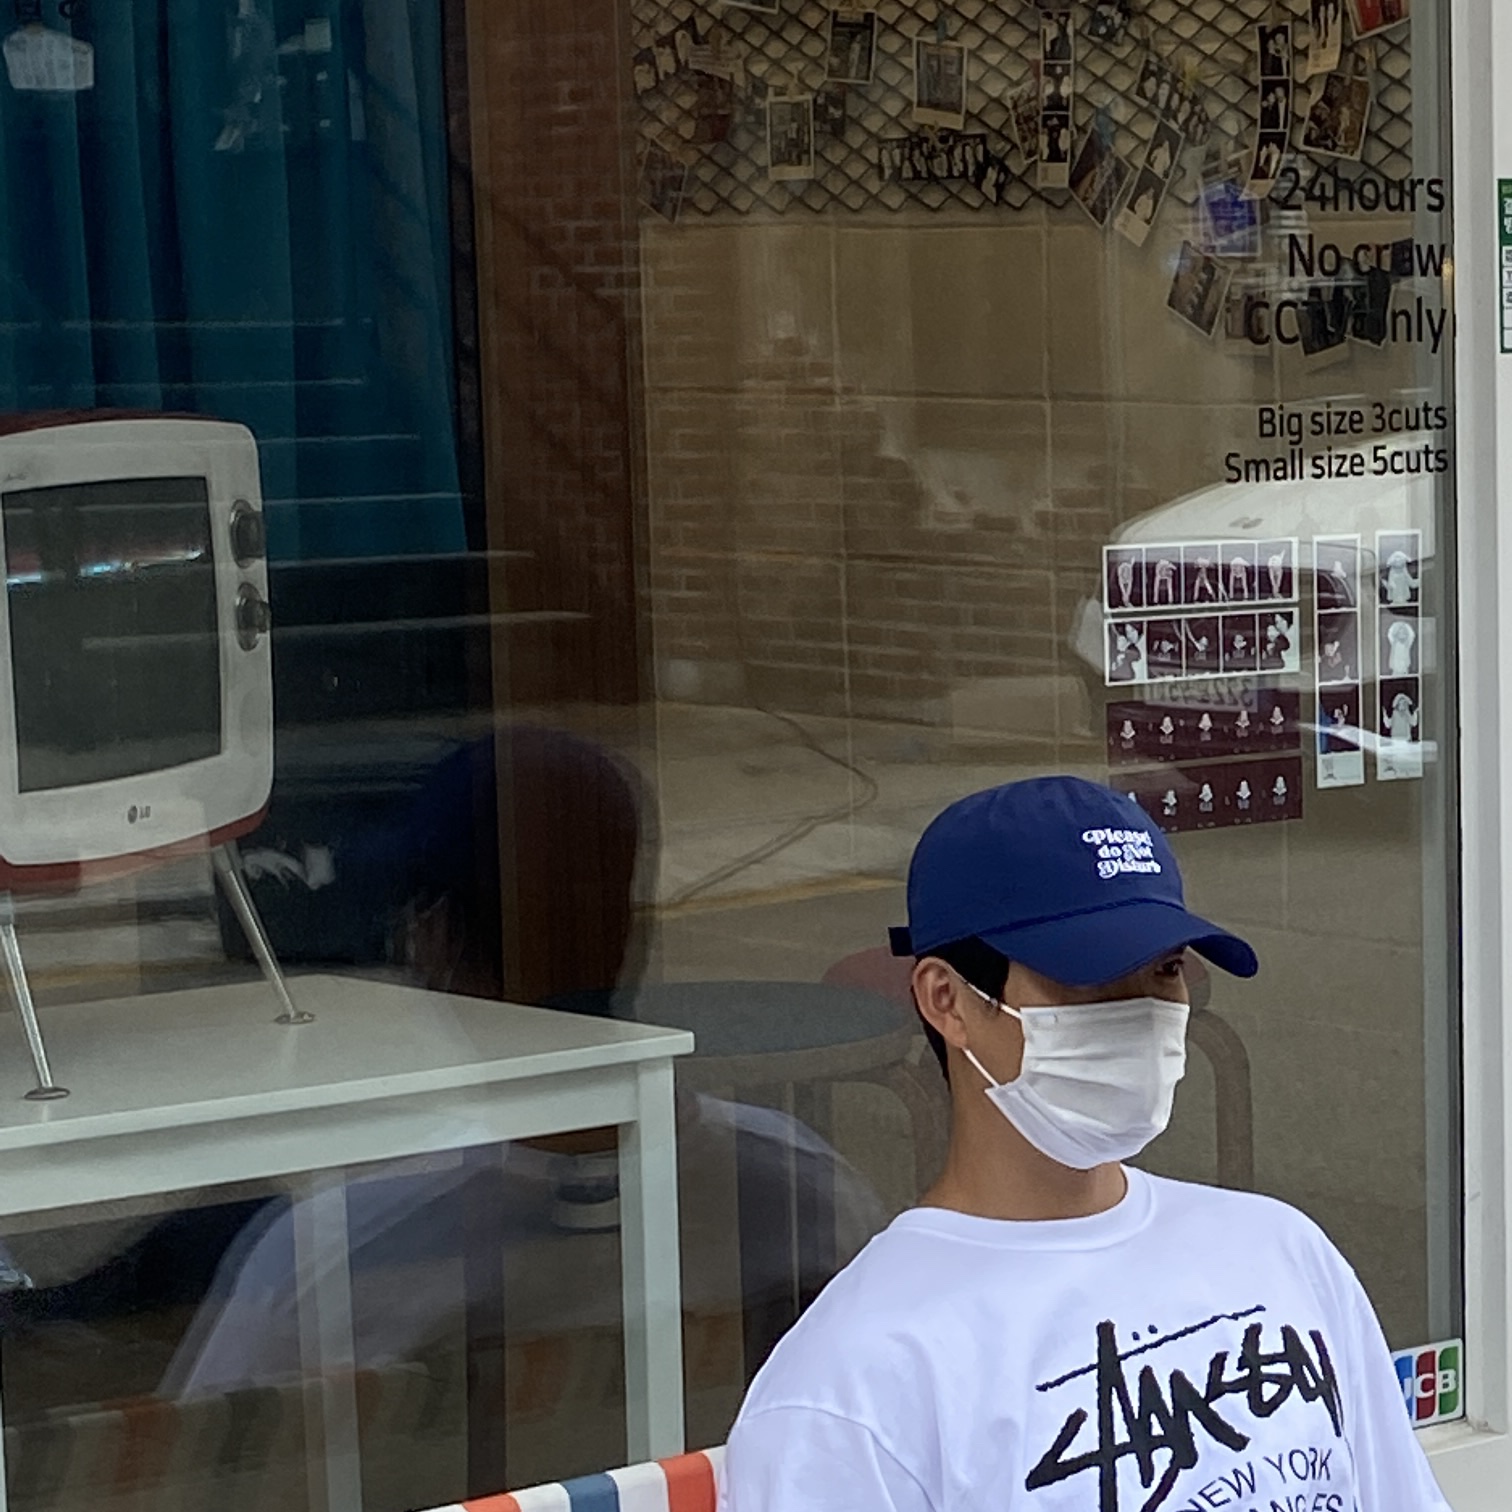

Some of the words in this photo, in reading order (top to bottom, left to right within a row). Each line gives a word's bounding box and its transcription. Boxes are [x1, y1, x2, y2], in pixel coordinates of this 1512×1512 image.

[1280, 166, 1446, 213] 24hours
[1287, 233, 1341, 278] No
[1258, 405, 1303, 446] Big
[1309, 402, 1364, 436] size
[1372, 401, 1448, 433] 3cuts
[1224, 448, 1304, 483] Small
[1310, 448, 1365, 480] size
[1372, 445, 1449, 476] 5cuts
[1262, 1446, 1333, 1485] YORK
